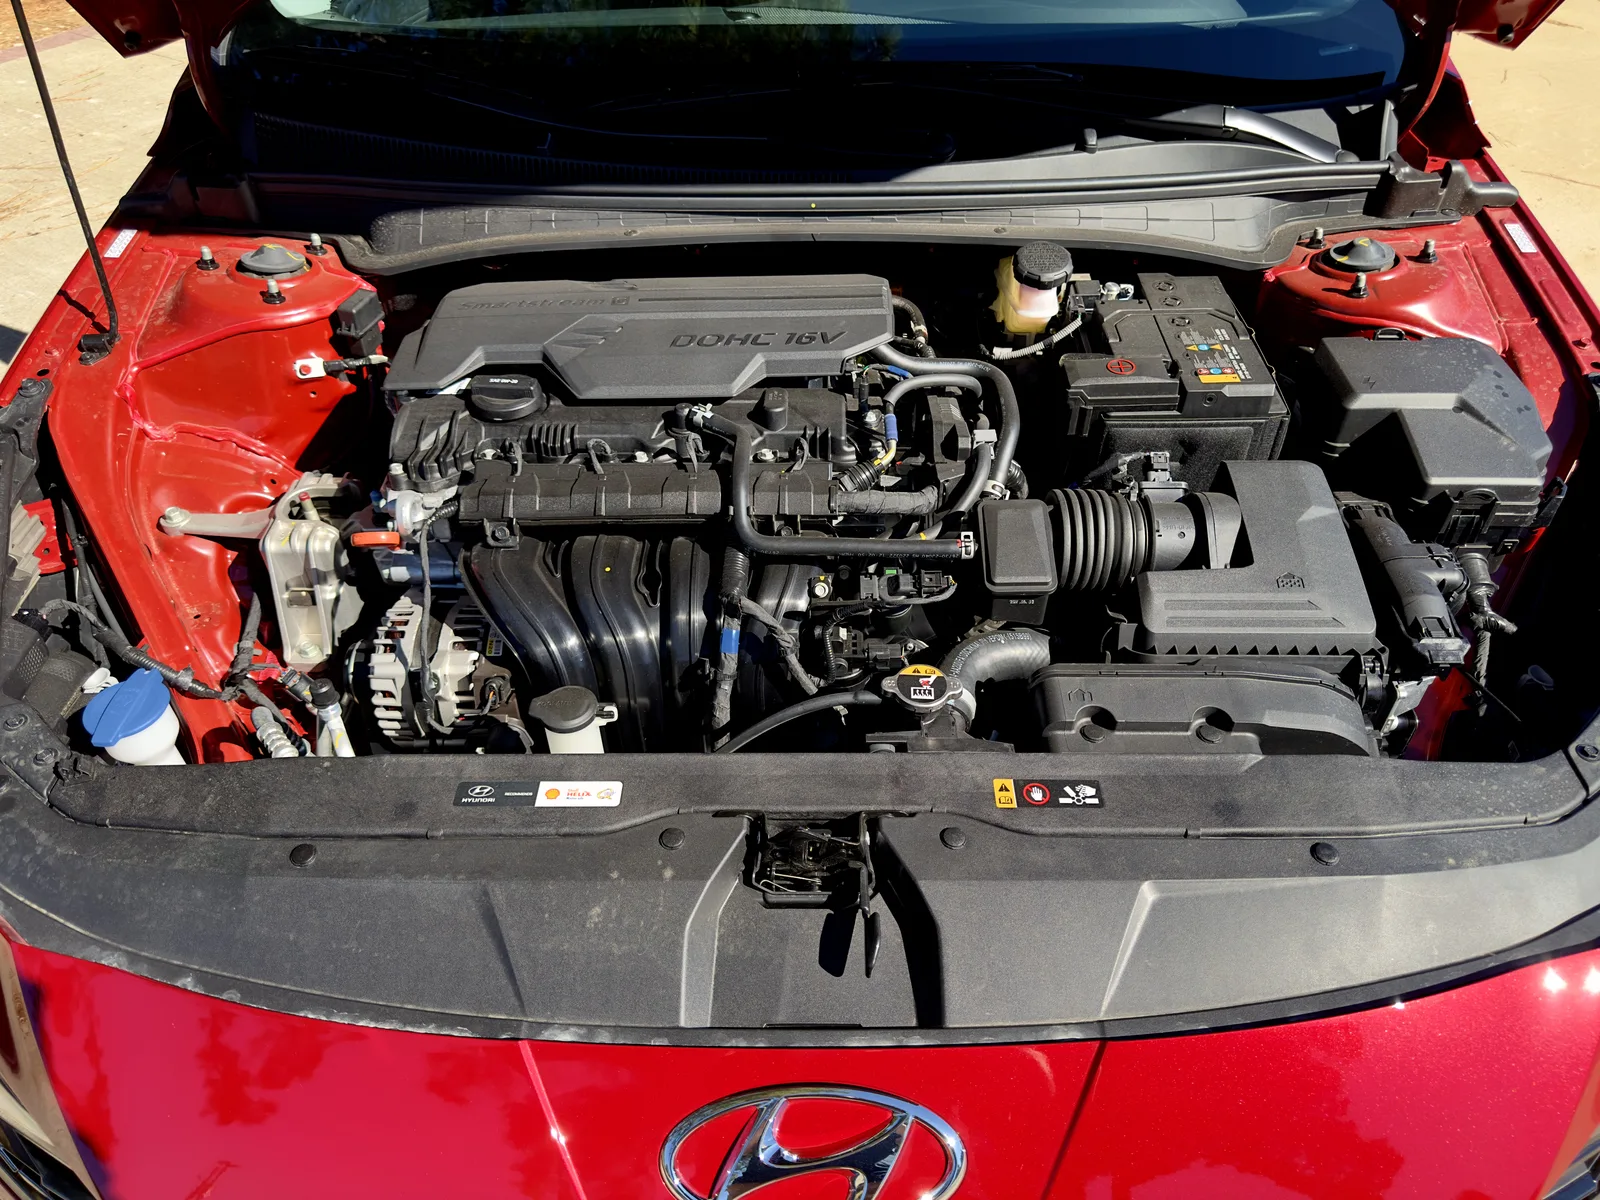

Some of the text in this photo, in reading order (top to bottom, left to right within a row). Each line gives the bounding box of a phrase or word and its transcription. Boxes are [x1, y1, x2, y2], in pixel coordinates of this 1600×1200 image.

[457, 297, 606, 311] Smartstream
[669, 329, 849, 348] DOHC 16V
